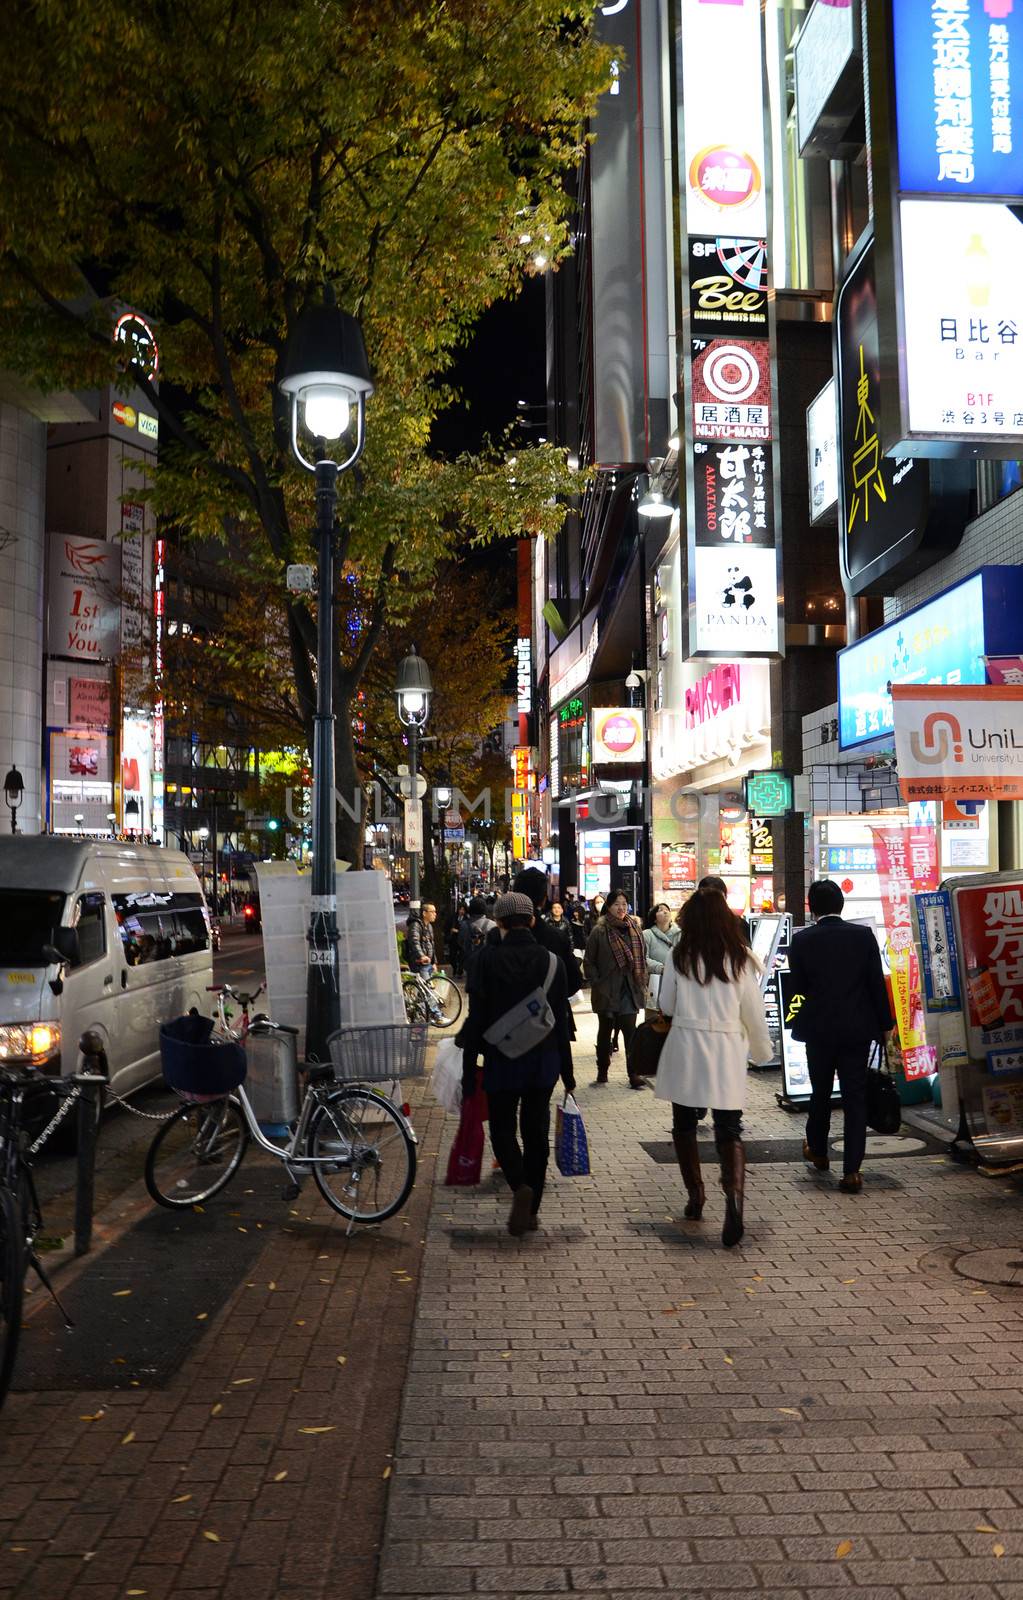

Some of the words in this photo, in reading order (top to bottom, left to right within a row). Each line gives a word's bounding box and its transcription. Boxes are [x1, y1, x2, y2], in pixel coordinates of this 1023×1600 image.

[692, 242, 717, 257] 8F
[691, 275, 766, 311] Bee
[694, 310, 721, 321] DINING
[723, 311, 748, 322] DARTS
[749, 313, 766, 323] BAR
[940, 318, 1018, 344] 日比谷
[692, 339, 706, 350] 7F
[955, 348, 1000, 360] Bar
[967, 393, 993, 406] B1F
[702, 405, 763, 424] 居酒屋
[942, 410, 1023, 426] 渋谷3号店
[140, 419, 158, 434] VISA
[695, 425, 770, 438] NIJYU-MARU
[716, 445, 752, 543] 甘太郎
[751, 446, 767, 528] 手作り居酒屋
[706, 465, 717, 531] AMATARO
[70, 590, 99, 618] 1st
[75, 618, 94, 631] for
[707, 614, 767, 625] PANDA
[971, 753, 1015, 765] University
[623, 851, 632, 862] P
